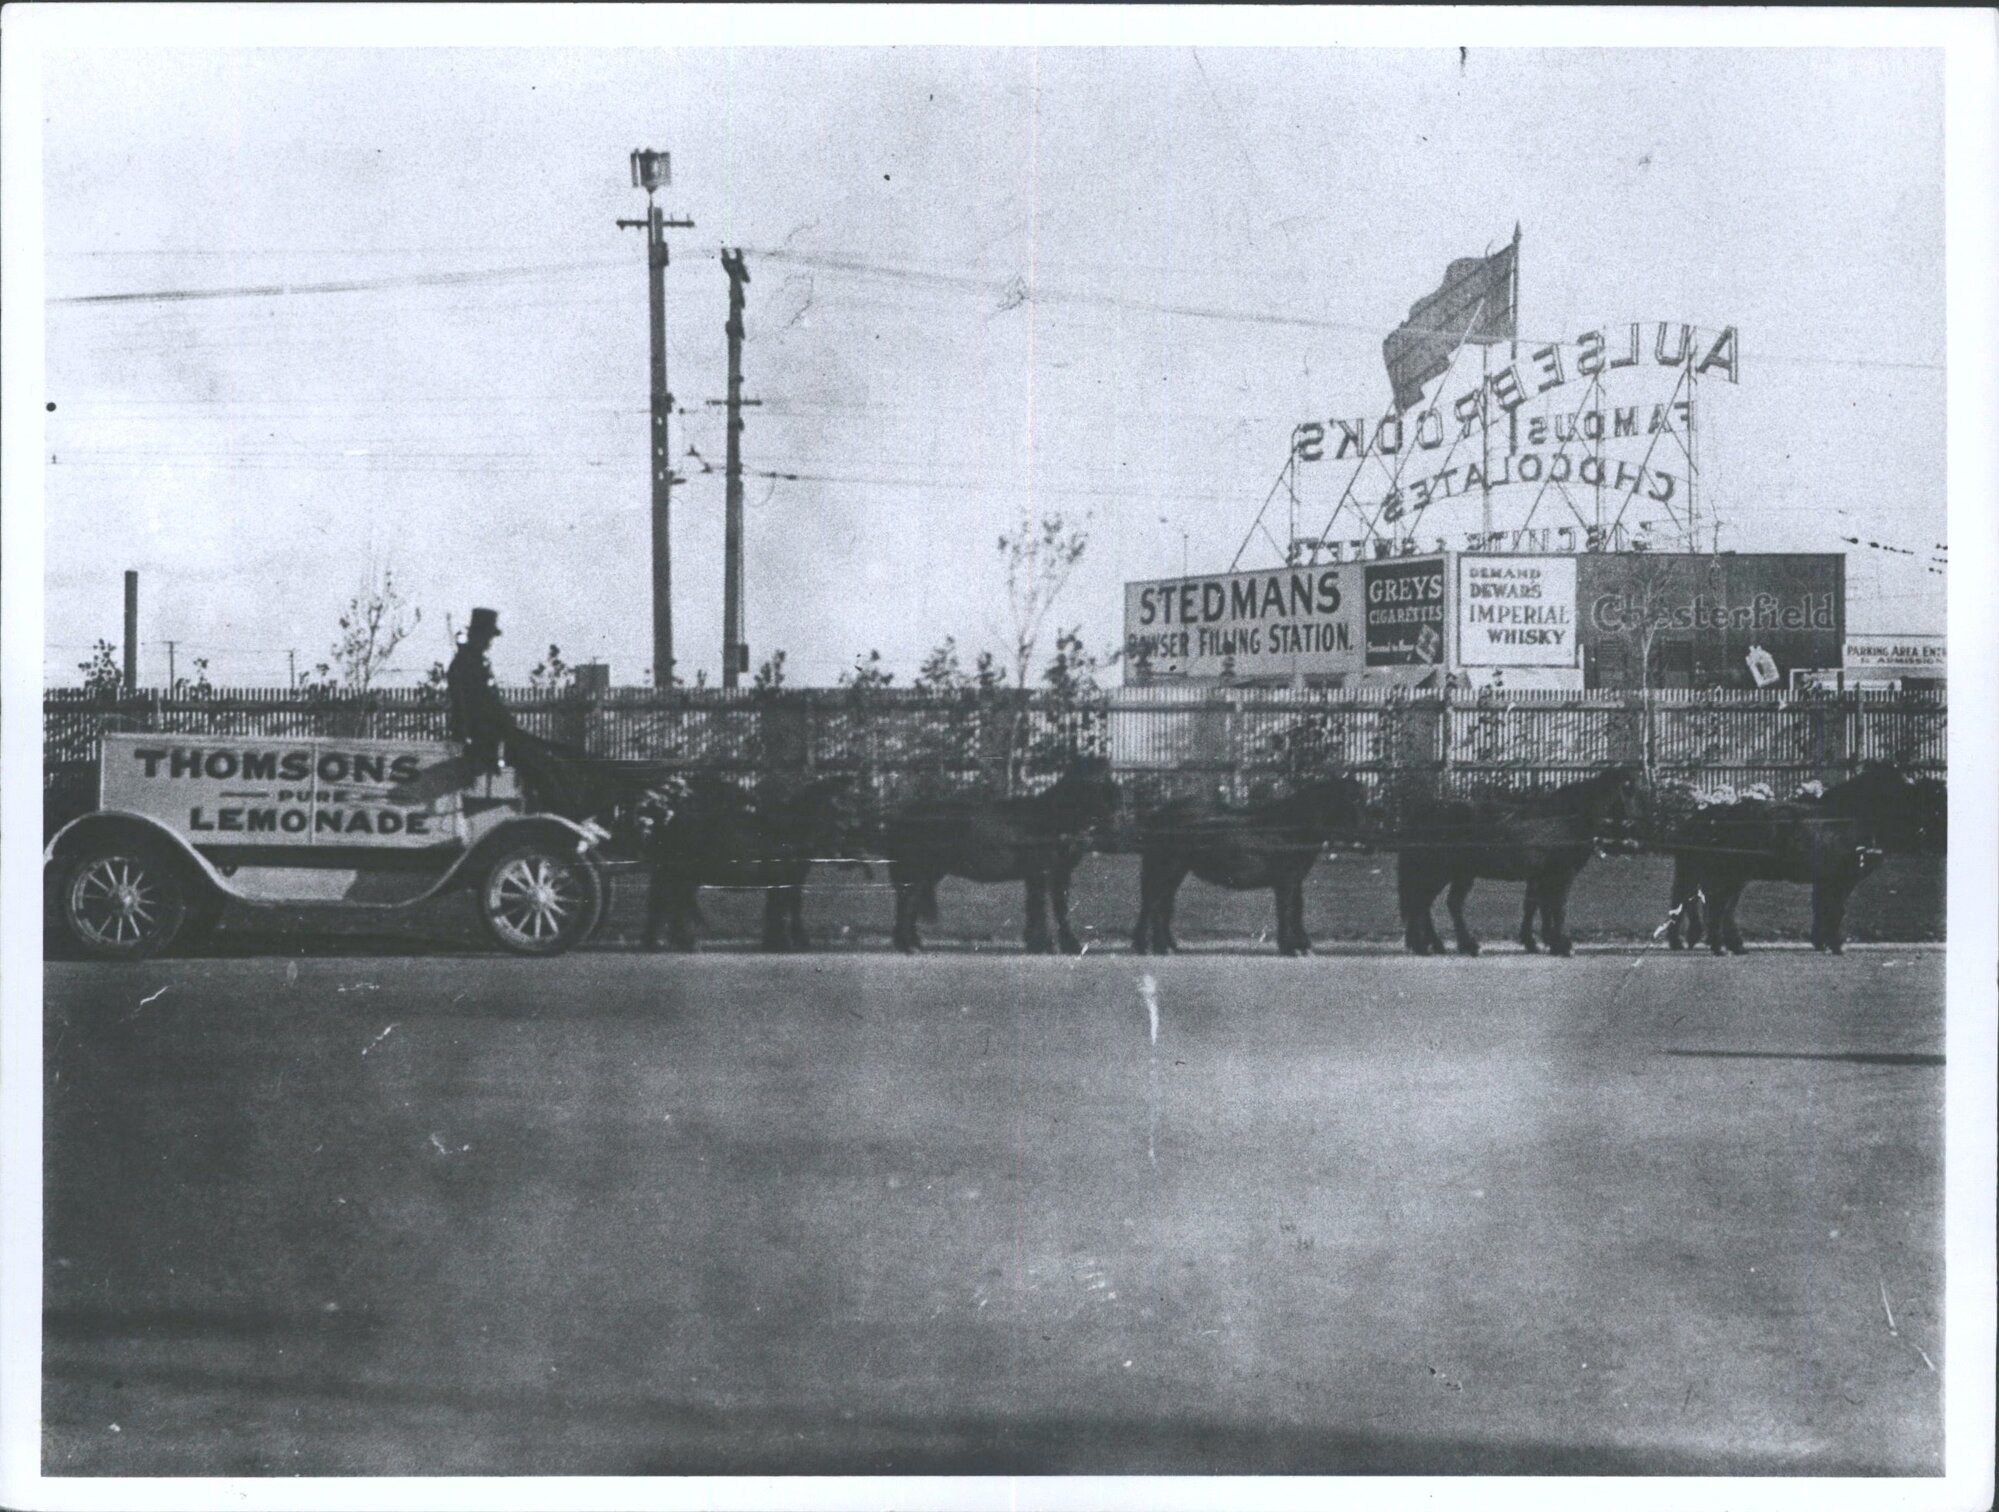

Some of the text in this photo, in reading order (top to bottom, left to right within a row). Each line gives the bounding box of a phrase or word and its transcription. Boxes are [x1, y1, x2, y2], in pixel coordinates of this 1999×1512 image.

[1469, 567, 1541, 579] DEMAND
[1139, 572, 1342, 625] STEDMANS
[1369, 574, 1442, 602] GREYS
[1369, 605, 1442, 624] CIGARETTES
[1470, 604, 1570, 624] IMPERIAL
[1591, 592, 1836, 634] Chesterfield
[1199, 626, 1261, 656] FILLING
[1487, 628, 1566, 645] WHISKY
[1847, 645, 1889, 656] PARKING
[1892, 645, 1919, 656] AREA
[134, 748, 421, 783] THOMSONS
[278, 789, 350, 803] PURE
[189, 807, 430, 834] LEMONADE
